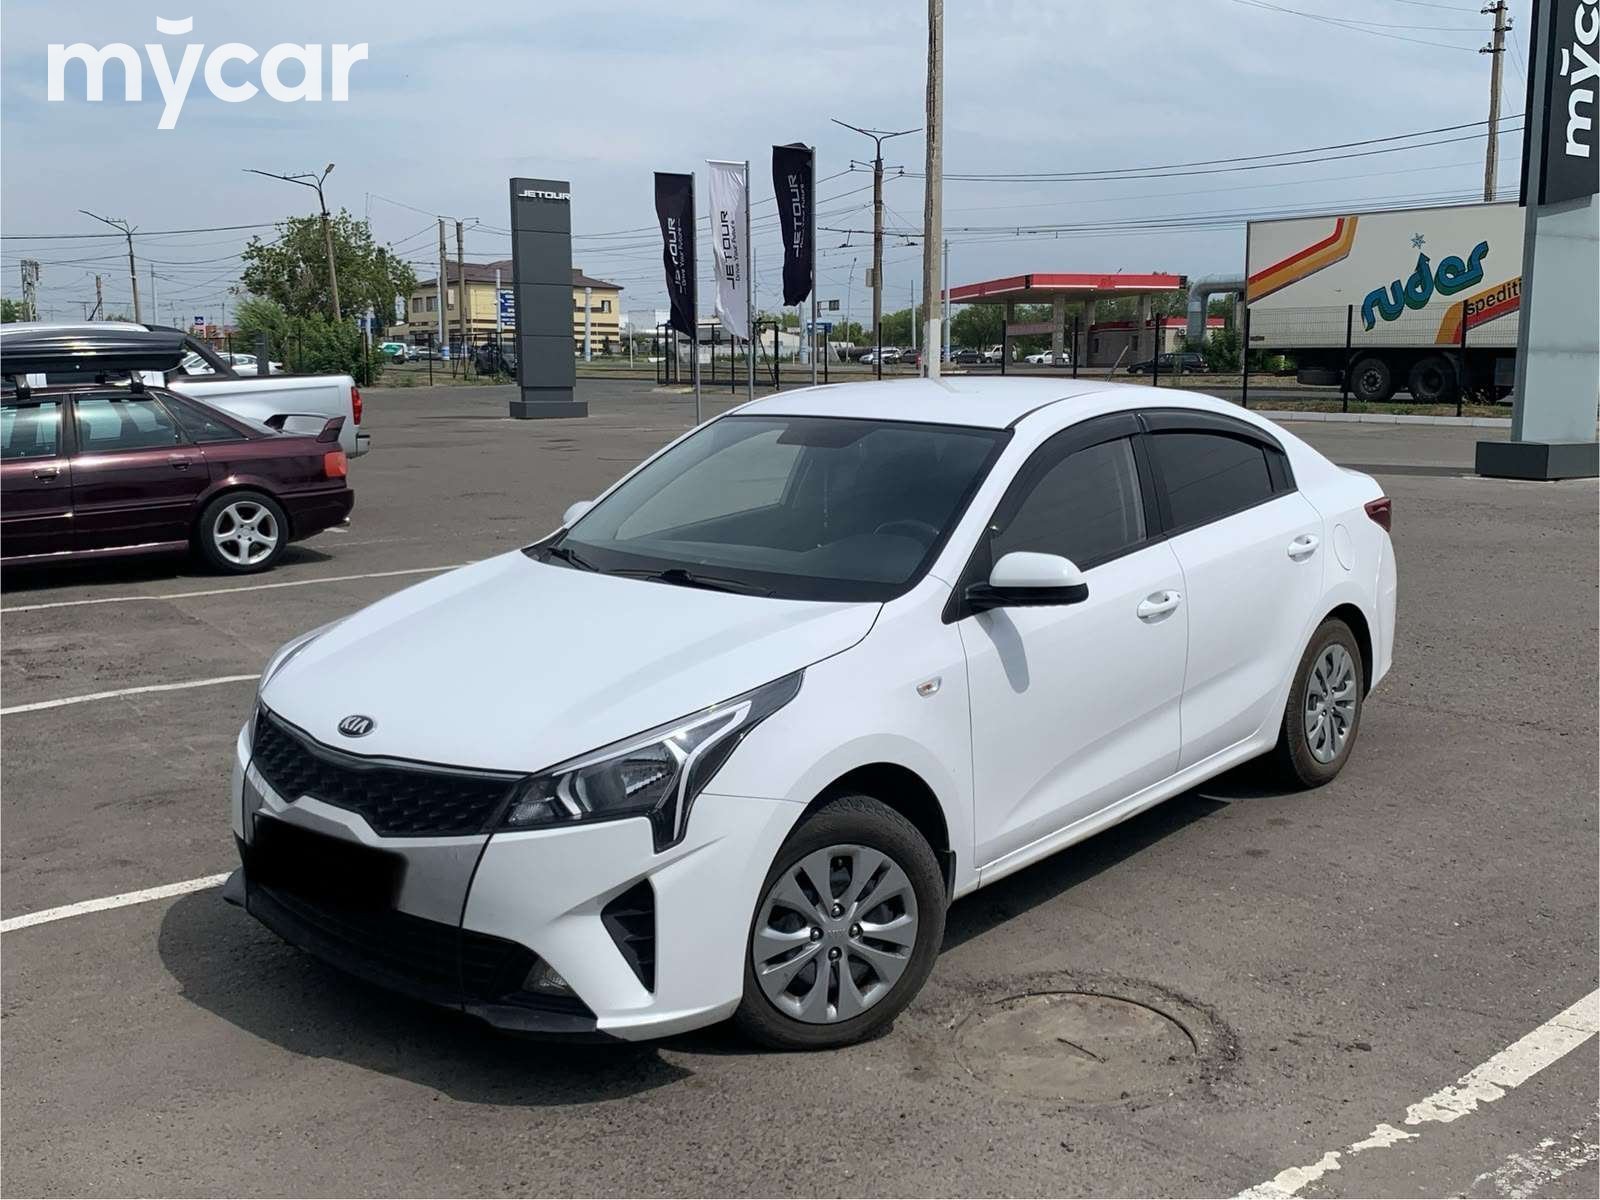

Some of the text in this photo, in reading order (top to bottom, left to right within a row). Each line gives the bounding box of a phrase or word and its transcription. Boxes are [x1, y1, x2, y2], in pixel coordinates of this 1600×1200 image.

[1560, 0, 1600, 158] myc
[518, 190, 572, 200] JETOUR
[788, 175, 802, 258] JETOUR
[720, 210, 736, 290] JETOUR
[340, 716, 370, 734] KIA
